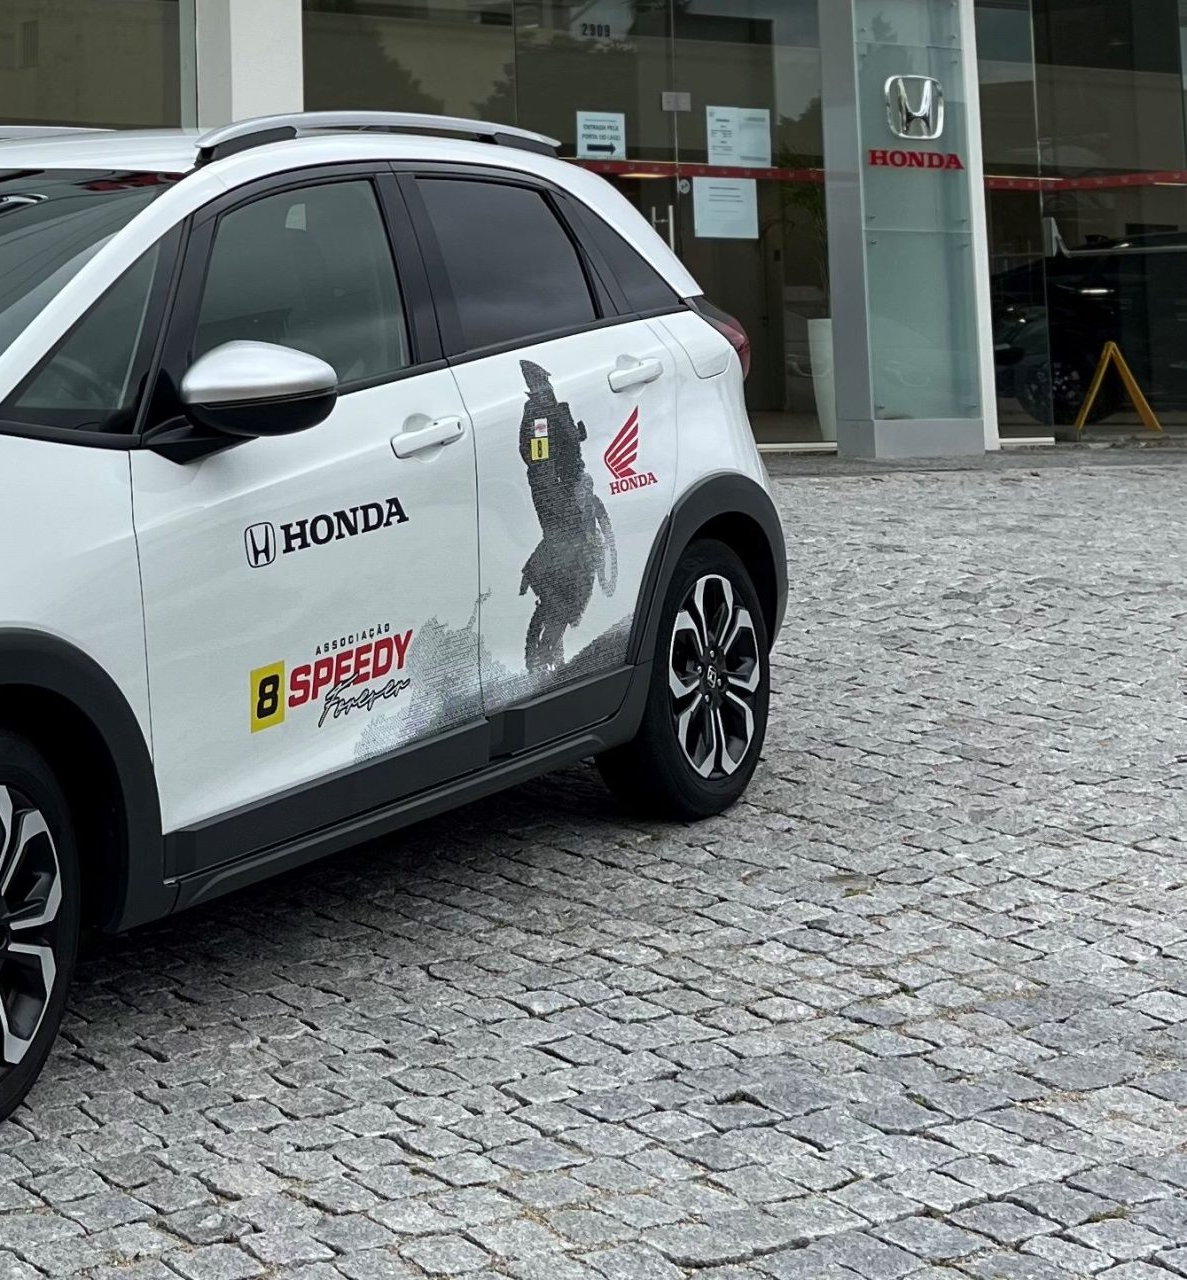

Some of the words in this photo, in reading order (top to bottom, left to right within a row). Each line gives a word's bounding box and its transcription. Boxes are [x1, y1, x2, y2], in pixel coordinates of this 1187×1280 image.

[581, 23, 611, 38] 2909
[868, 149, 965, 170] HONDA
[609, 471, 658, 495] HONDA
[280, 497, 410, 554] HONDA
[316, 623, 390, 655] ASSOCIAÇÃO
[257, 674, 279, 719] 8
[288, 629, 413, 708] SPEEDY
